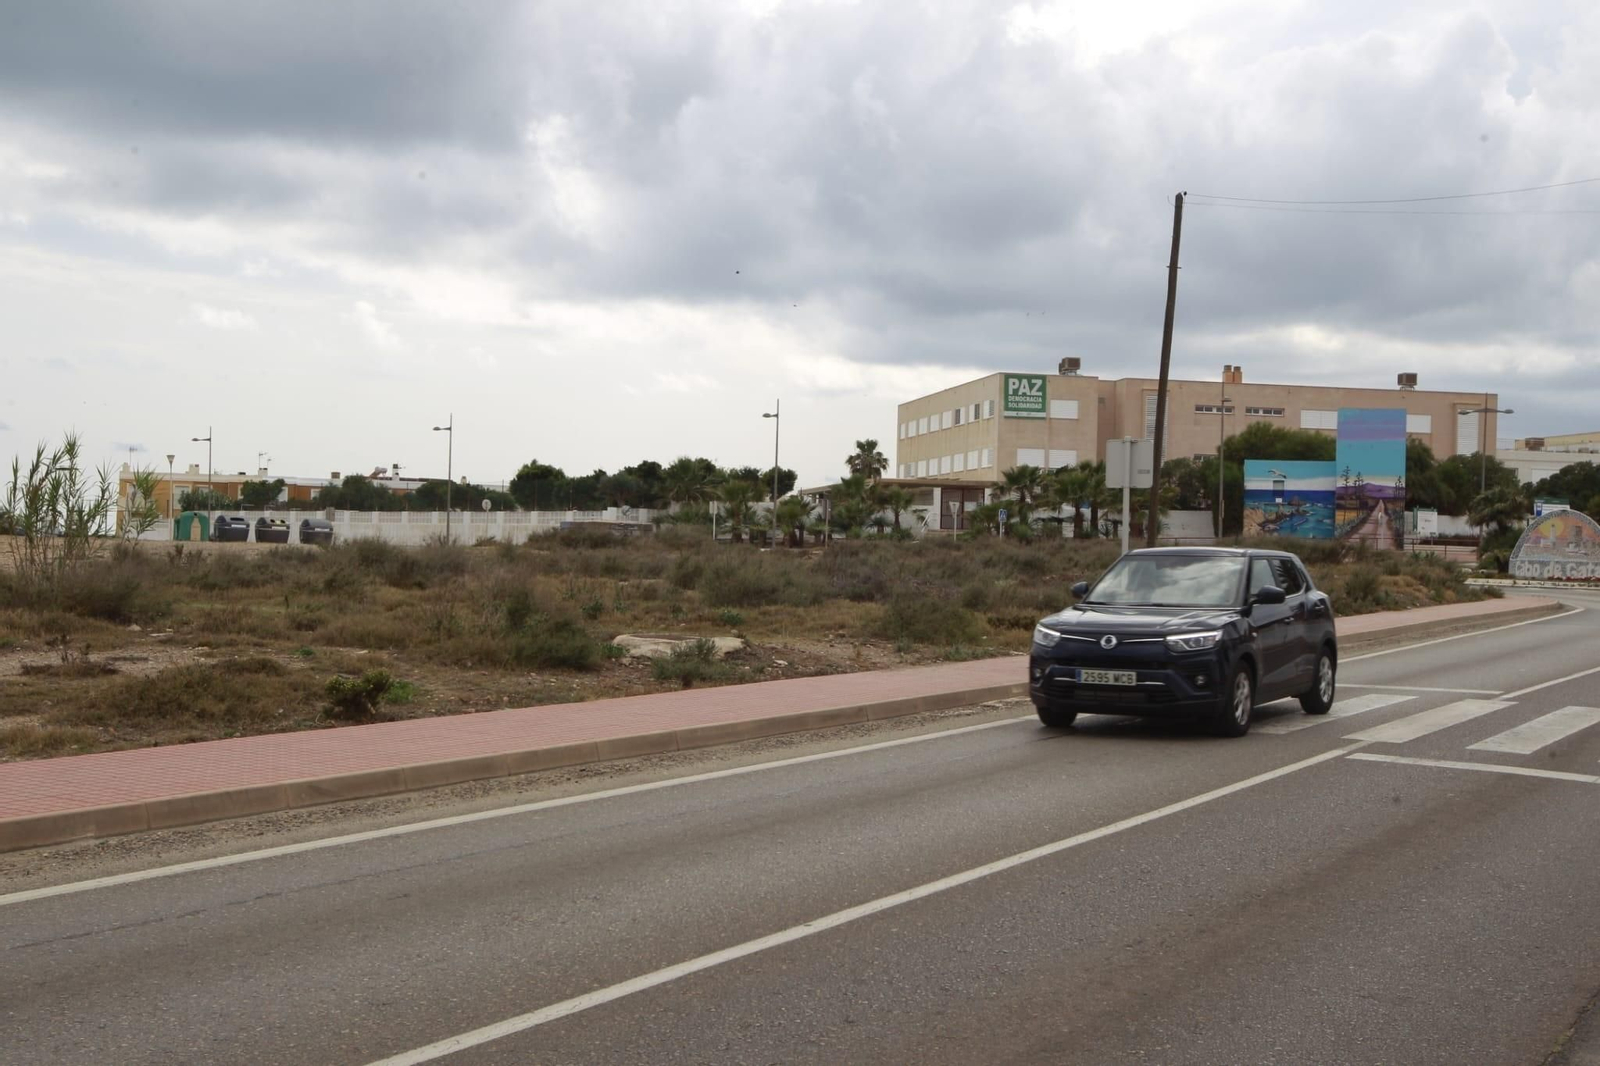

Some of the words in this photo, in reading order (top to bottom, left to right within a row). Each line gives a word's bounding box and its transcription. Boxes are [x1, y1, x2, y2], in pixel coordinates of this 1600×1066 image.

[1008, 378, 1042, 396] PAZ
[1515, 561, 1540, 577] Cabo
[1543, 561, 1563, 578] de
[1083, 671, 1110, 683] 2595
